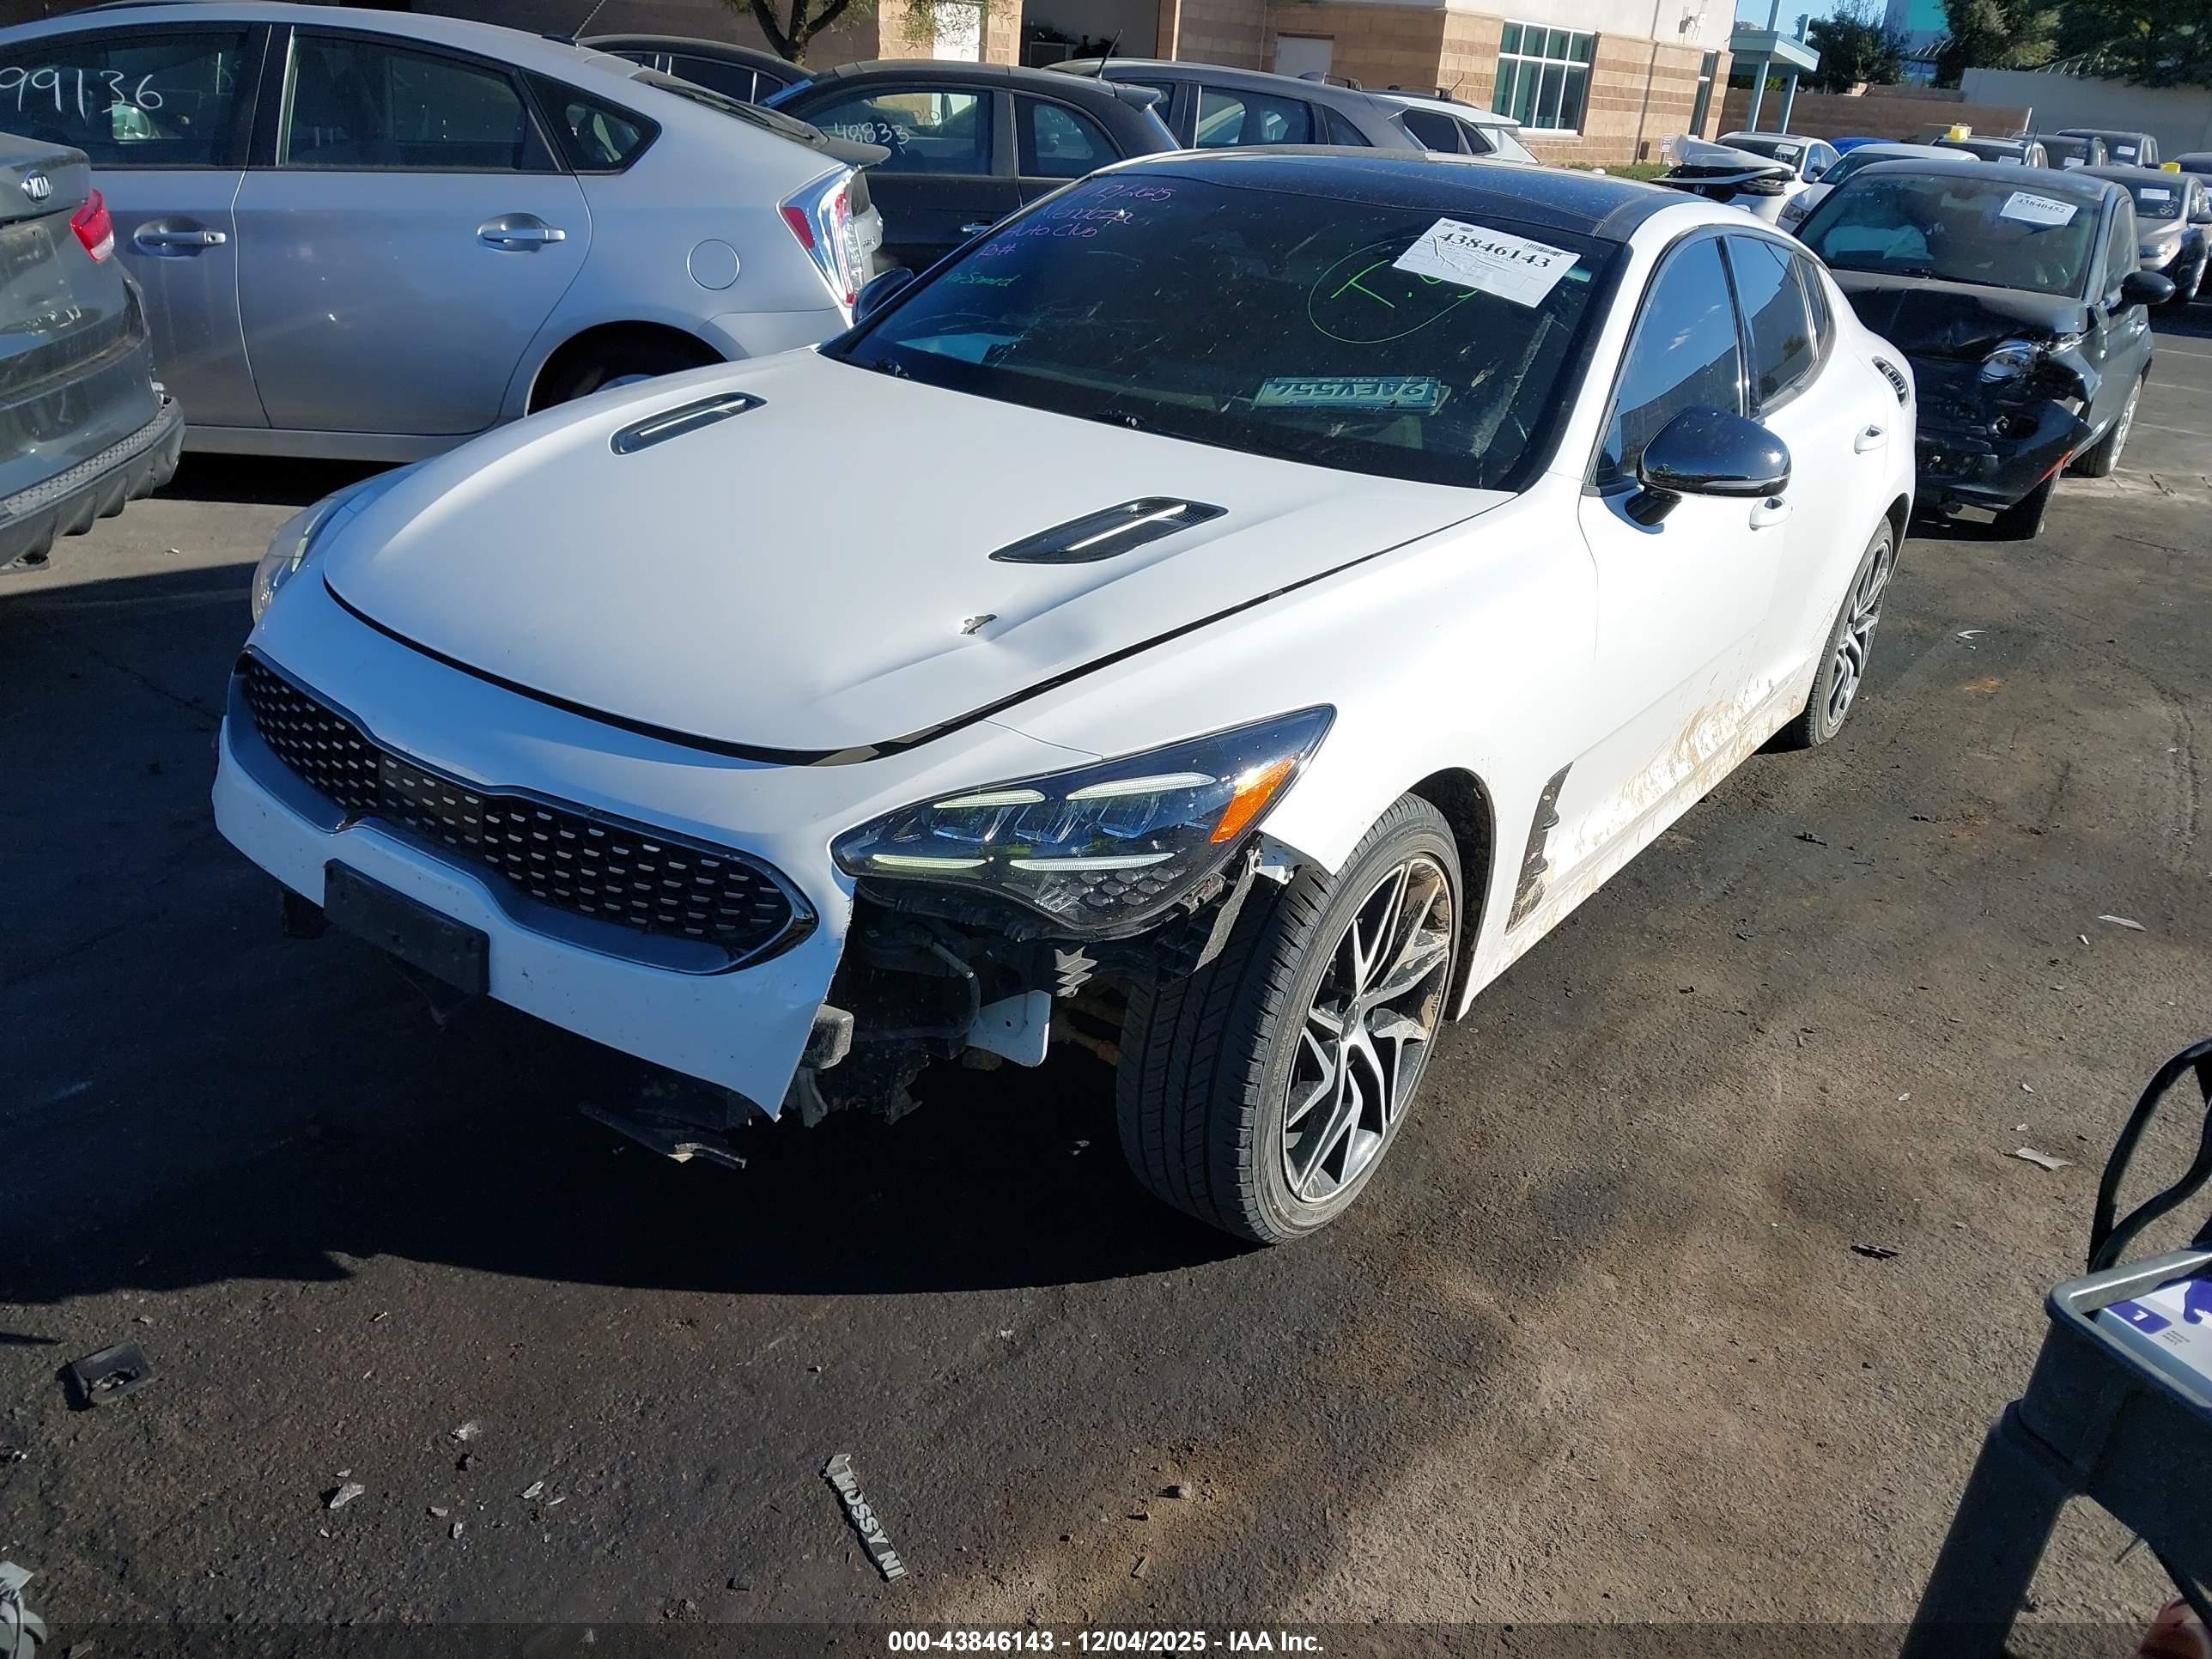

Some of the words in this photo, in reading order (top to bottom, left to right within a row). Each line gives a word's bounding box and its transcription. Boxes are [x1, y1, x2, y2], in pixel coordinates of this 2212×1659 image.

[29, 176, 52, 198] KIA
[998, 222, 1050, 239] Auto
[1052, 222, 1098, 238] Club
[1438, 232, 1552, 268] 43846143
